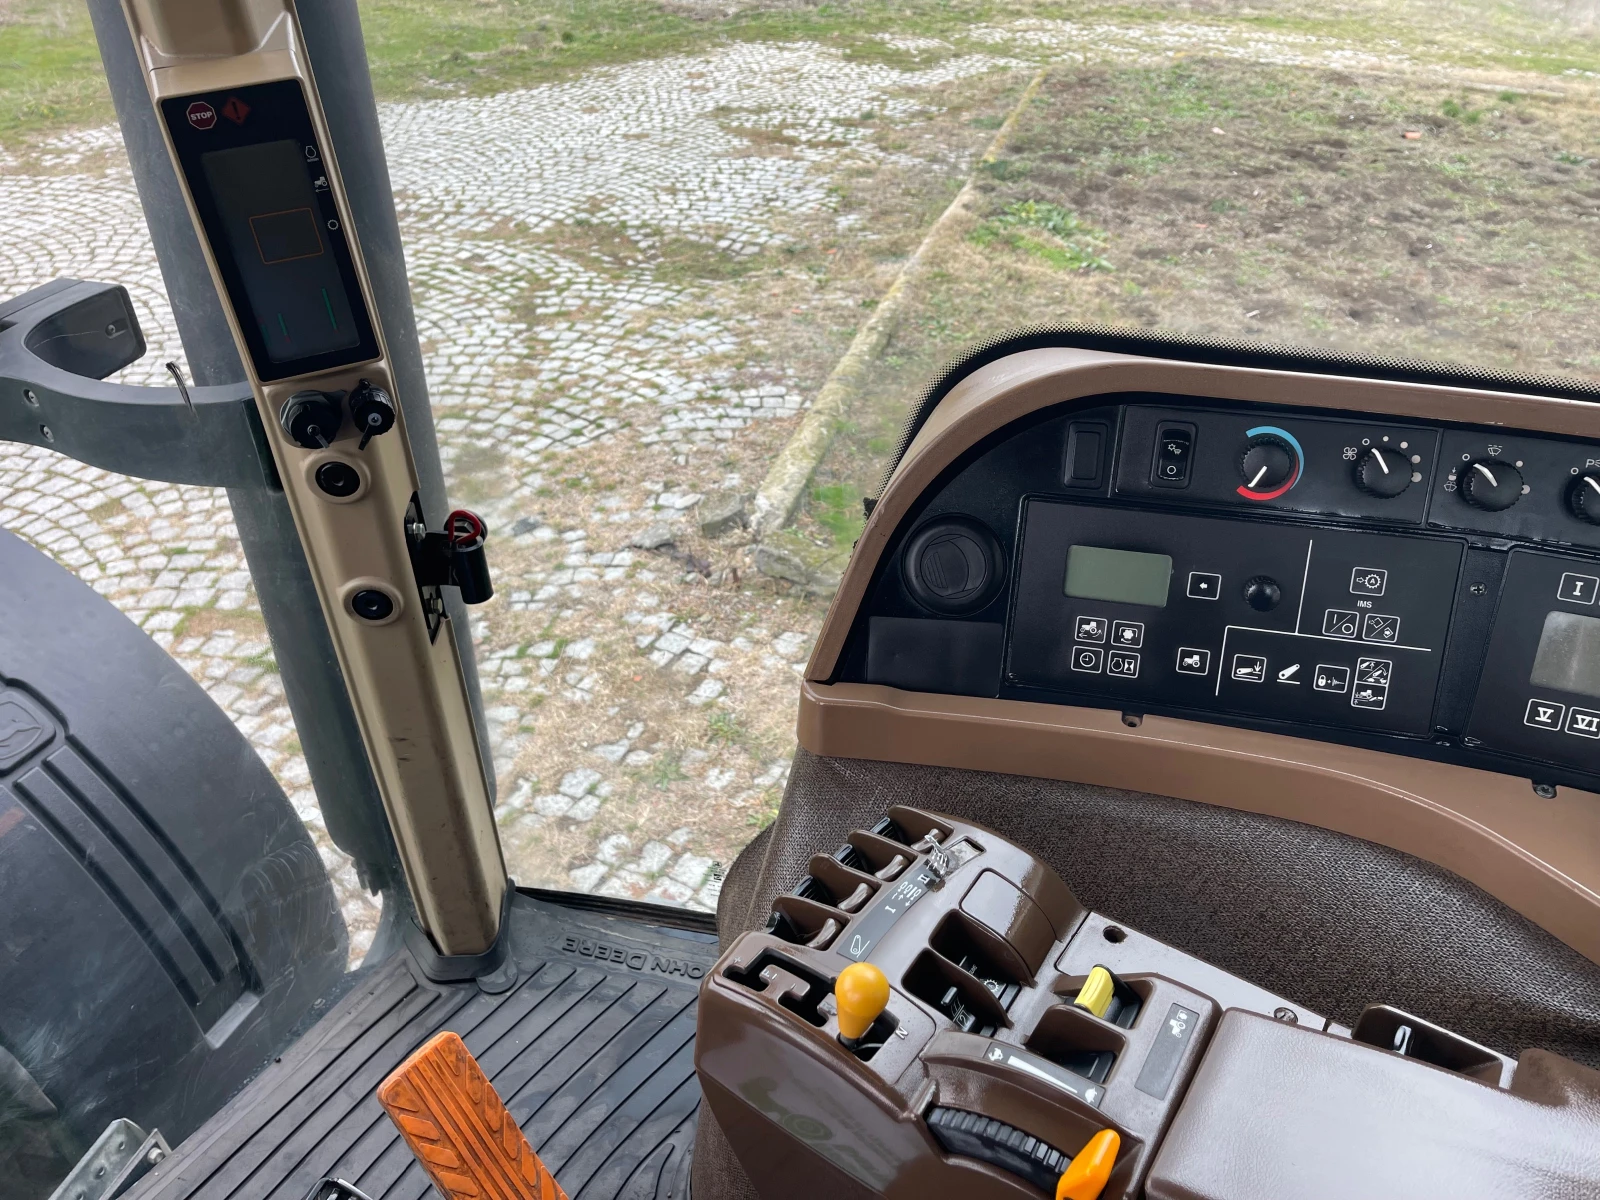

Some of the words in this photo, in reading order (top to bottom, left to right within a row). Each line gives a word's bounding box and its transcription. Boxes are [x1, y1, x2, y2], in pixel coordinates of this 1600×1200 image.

[190, 111, 213, 121] STOP
[1357, 600, 1373, 609] IMS
[562, 938, 647, 970] DEERE
[650, 957, 706, 979] OHN
